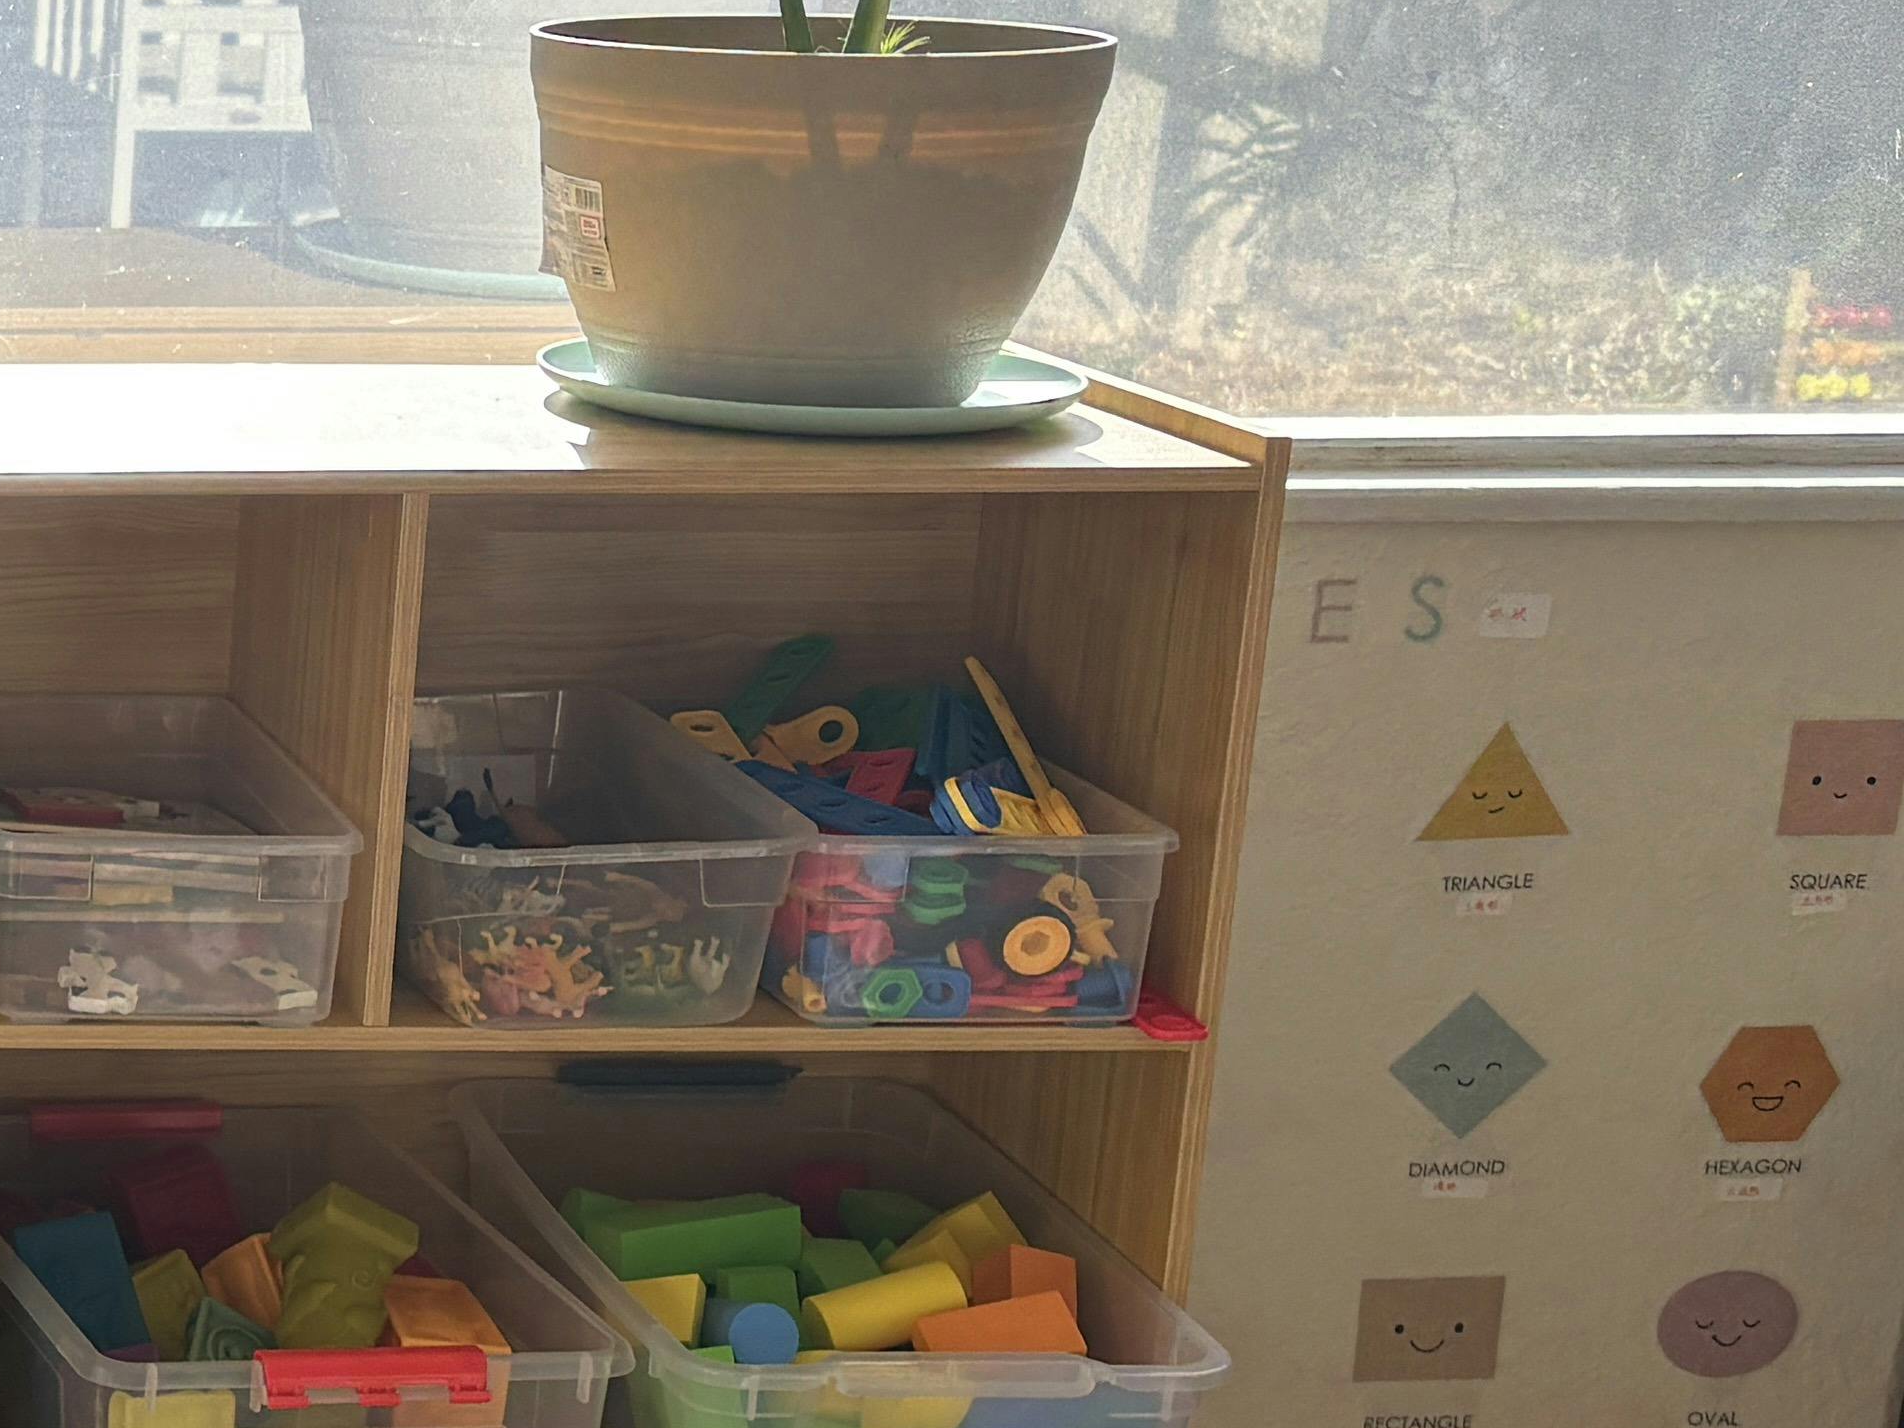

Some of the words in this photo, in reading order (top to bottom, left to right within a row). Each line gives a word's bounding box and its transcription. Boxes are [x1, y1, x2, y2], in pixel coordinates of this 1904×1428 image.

[1442, 873, 1534, 892] TRIANGLE
[1789, 873, 1868, 890] SQUARE
[1408, 1160, 1505, 1177] DIAMOND
[1705, 1158, 1802, 1175] HEXAGON
[1687, 1411, 1743, 1427] OVAL
